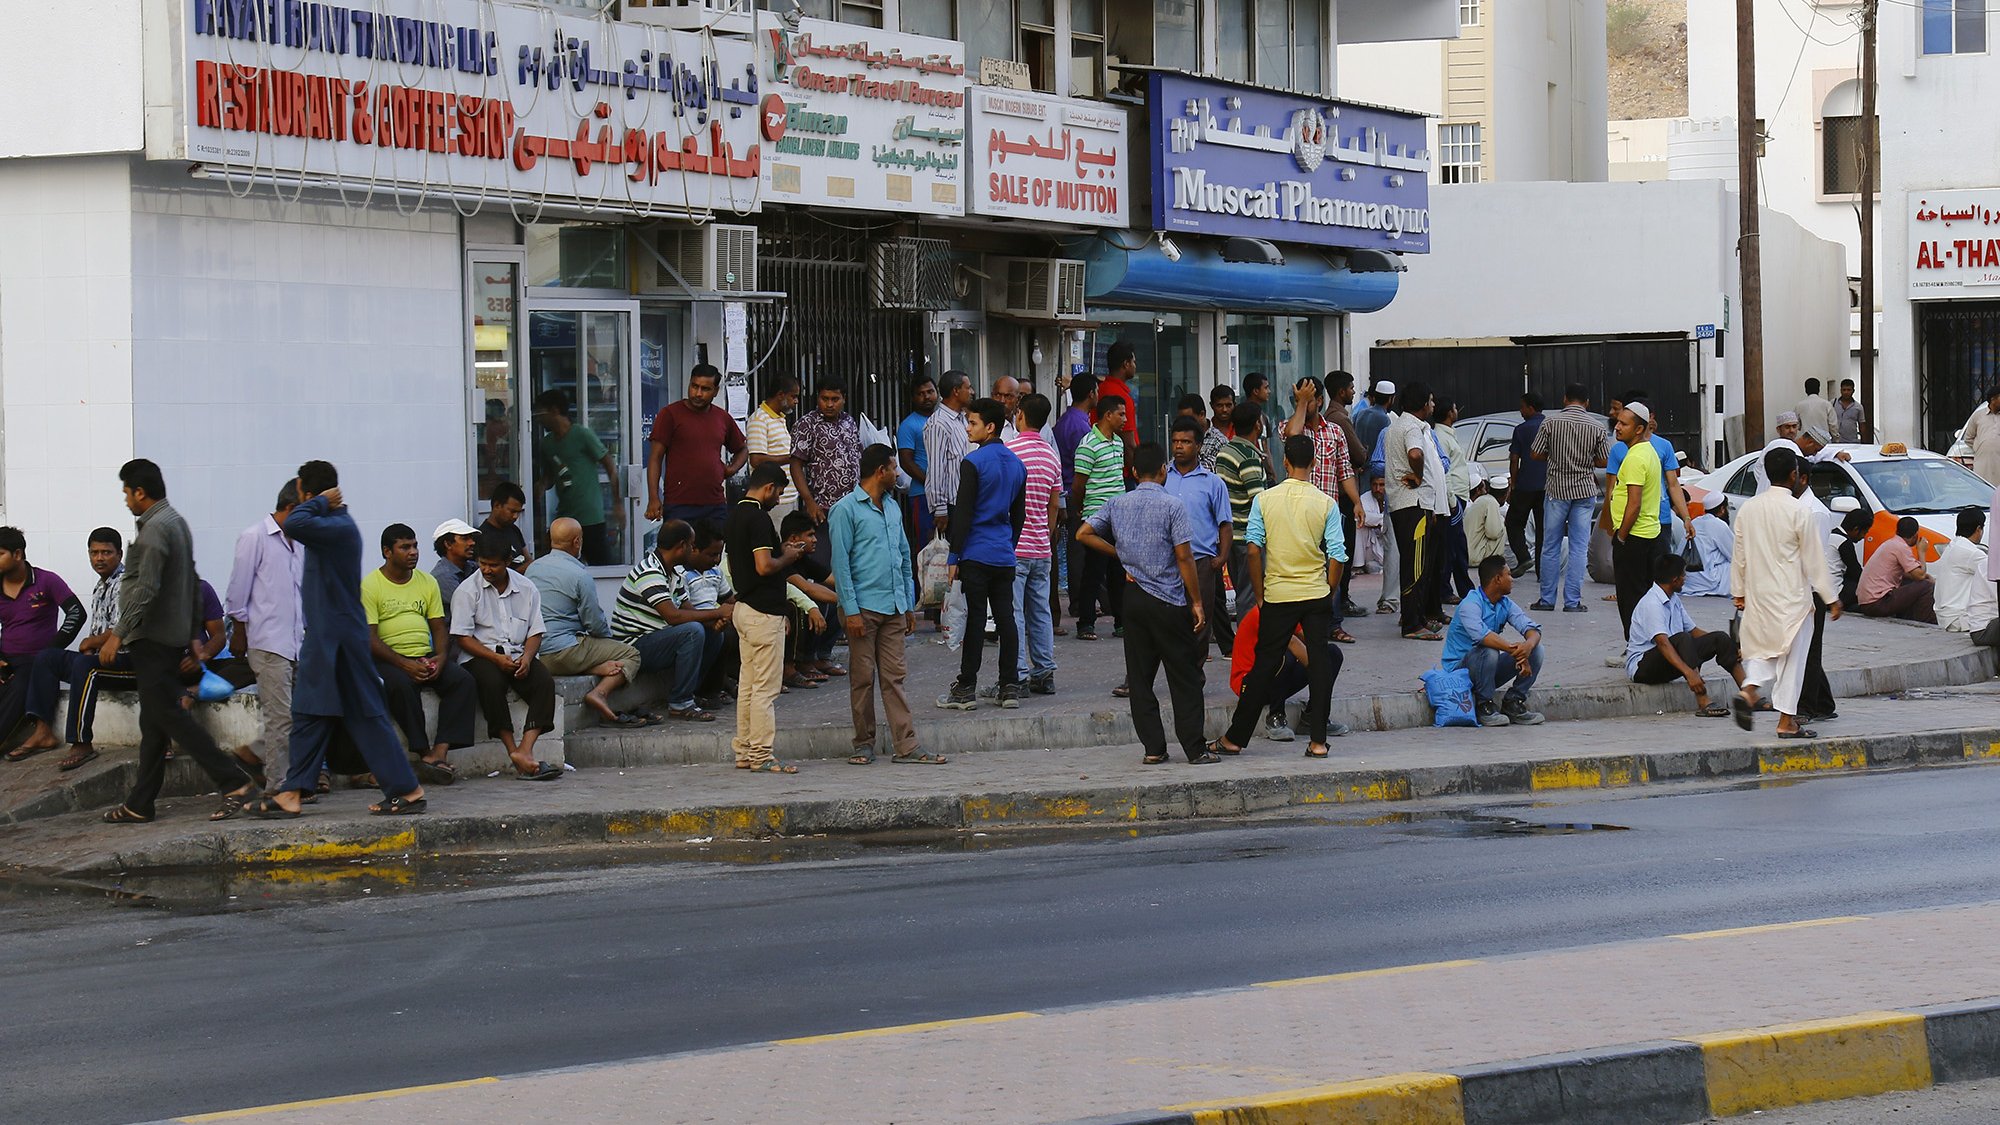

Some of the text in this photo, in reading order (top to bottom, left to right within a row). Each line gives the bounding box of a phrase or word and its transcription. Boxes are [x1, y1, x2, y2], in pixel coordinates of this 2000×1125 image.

[351, 10, 456, 69] TRADING
[196, 60, 514, 160] RESTAURANT & COFFEE SHOP
[791, 65, 963, 108] Oman Travel Bureau
[785, 102, 849, 135] Biman
[1198, 96, 1297, 154] مسقط
[775, 136, 860, 161] BANGLADESH AIRLINES
[989, 126, 1117, 180] بيع اللحوم
[1324, 106, 1432, 188] صيدلية
[989, 172, 1117, 214] SALE OF MUTTON
[1172, 167, 1280, 219] Muscat
[1280, 180, 1403, 240] Pharmacy
